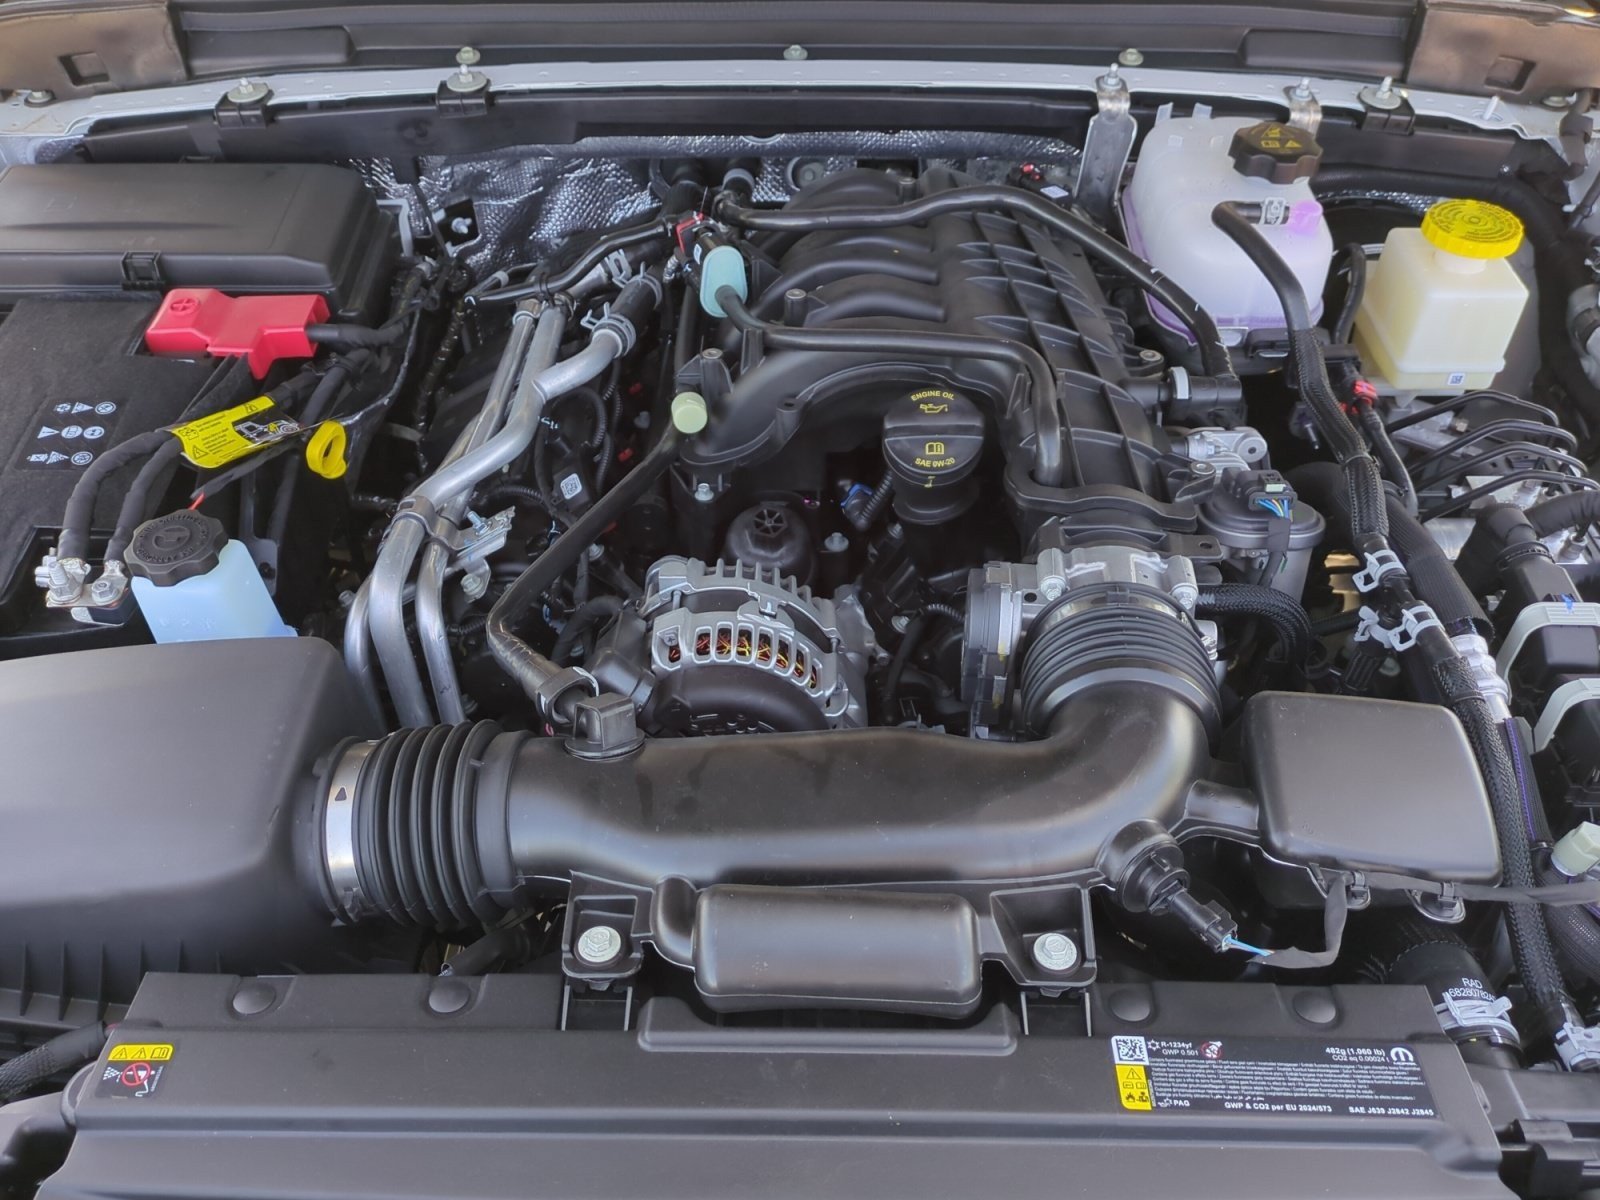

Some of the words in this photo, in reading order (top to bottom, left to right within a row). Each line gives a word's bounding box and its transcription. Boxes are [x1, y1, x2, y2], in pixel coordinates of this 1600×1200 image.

[911, 390, 941, 401] ENGINE
[942, 391, 955, 401] OIL
[915, 457, 932, 468] SAE
[932, 457, 956, 468] 0W-20
[1461, 977, 1483, 989] RAD
[1224, 1101, 1244, 1109] GWP
[1252, 1102, 1270, 1110] CO2
[1271, 1103, 1284, 1111] per
[1285, 1103, 1297, 1111] EU
